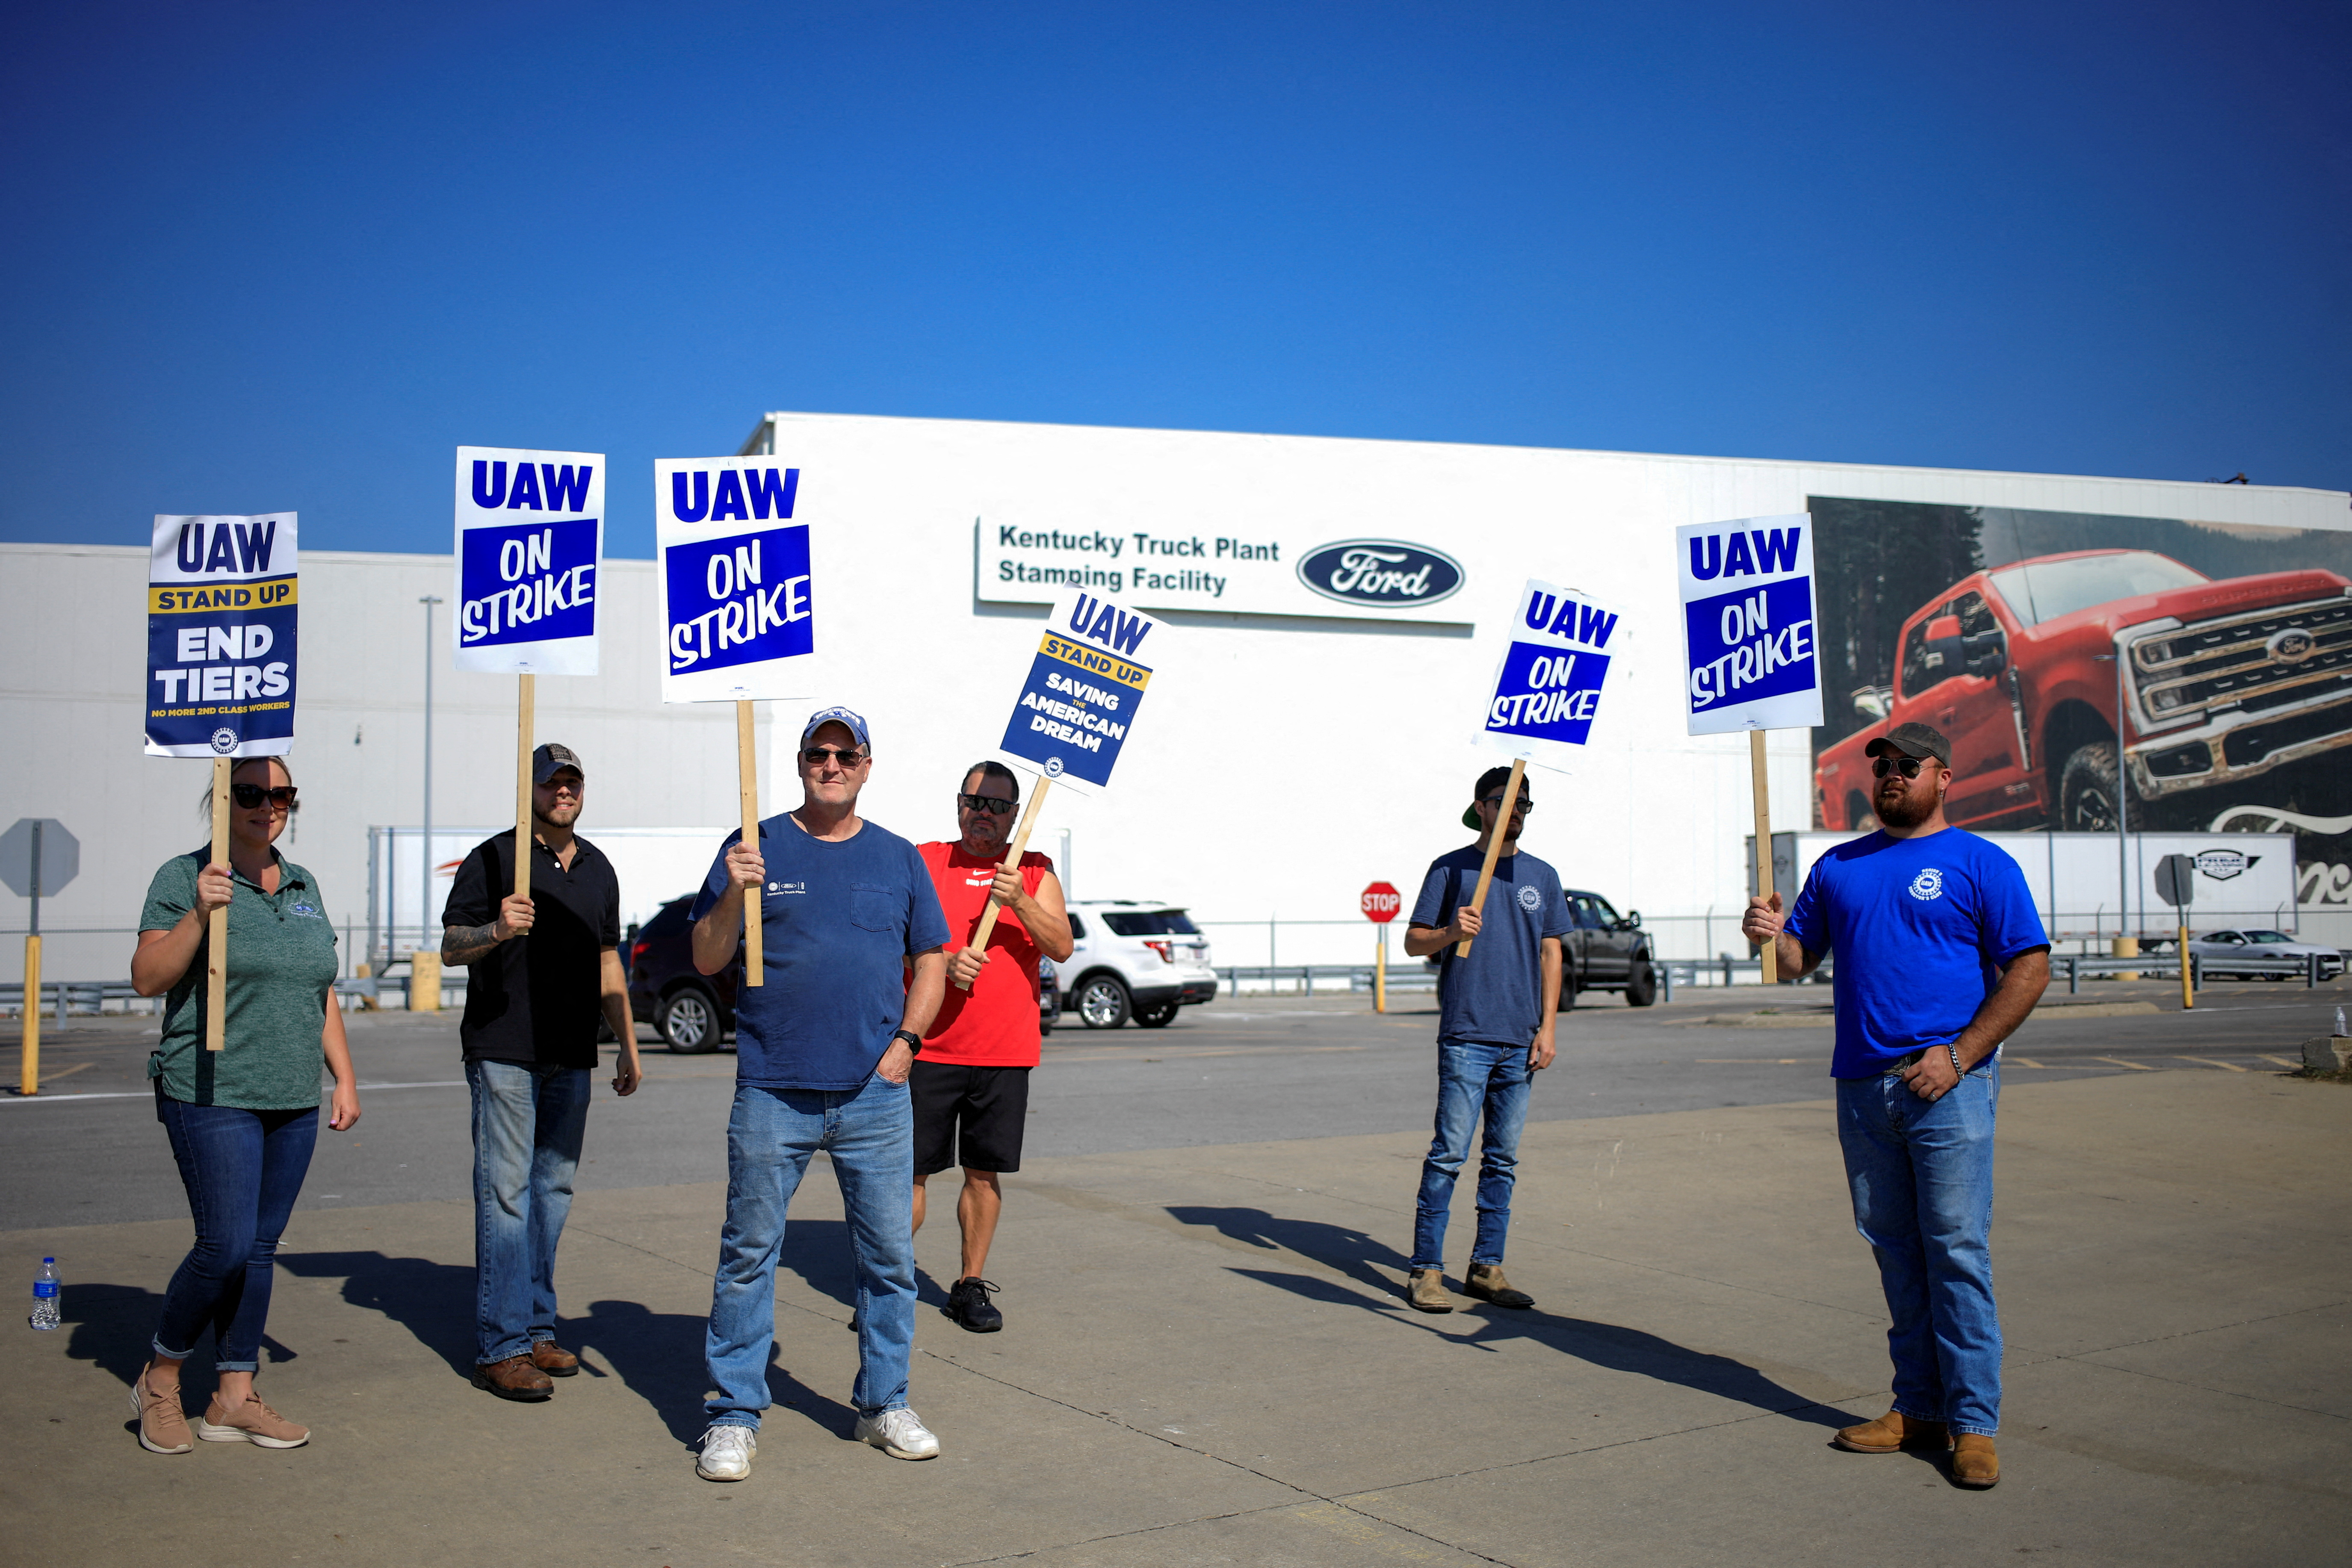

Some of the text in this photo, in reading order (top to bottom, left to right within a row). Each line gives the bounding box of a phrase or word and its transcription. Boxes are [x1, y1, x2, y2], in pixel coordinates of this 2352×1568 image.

[472, 460, 593, 512] UAW
[672, 468, 800, 523] UAW
[177, 521, 276, 573] UAW
[500, 529, 552, 581] ON
[999, 525, 1279, 561] Kentucky Truck Plant
[1689, 527, 1801, 580] UAW
[707, 539, 761, 599] ON
[999, 560, 1226, 598] Stamping Facility
[1330, 548, 1433, 596] Ford
[158, 584, 290, 609] STAND UP
[462, 564, 595, 642] STRIKE
[1721, 590, 1768, 645] ON
[670, 574, 810, 669] STRIKE
[1070, 593, 1152, 656] UAW
[1526, 590, 1619, 649] UAW
[177, 624, 274, 662] END
[1046, 639, 1143, 684] STAND UP
[1690, 620, 1813, 708] STRIKE
[155, 661, 290, 703] TIERS
[1045, 672, 1120, 711] SAVING
[1528, 654, 1577, 689] ON
[168, 708, 195, 716] MORE
[197, 707, 216, 715] 2ND
[218, 705, 248, 714] CLASS
[249, 701, 290, 712] WORKERS
[1020, 691, 1126, 741] AMERICAN
[1072, 699, 1087, 709] THE
[1488, 689, 1600, 728] STRIKE
[1030, 715, 1102, 753] DREAM
[980, 878, 994, 886] STAT
[1362, 893, 1399, 912] STOP
[1930, 891, 1942, 900] CLUB
